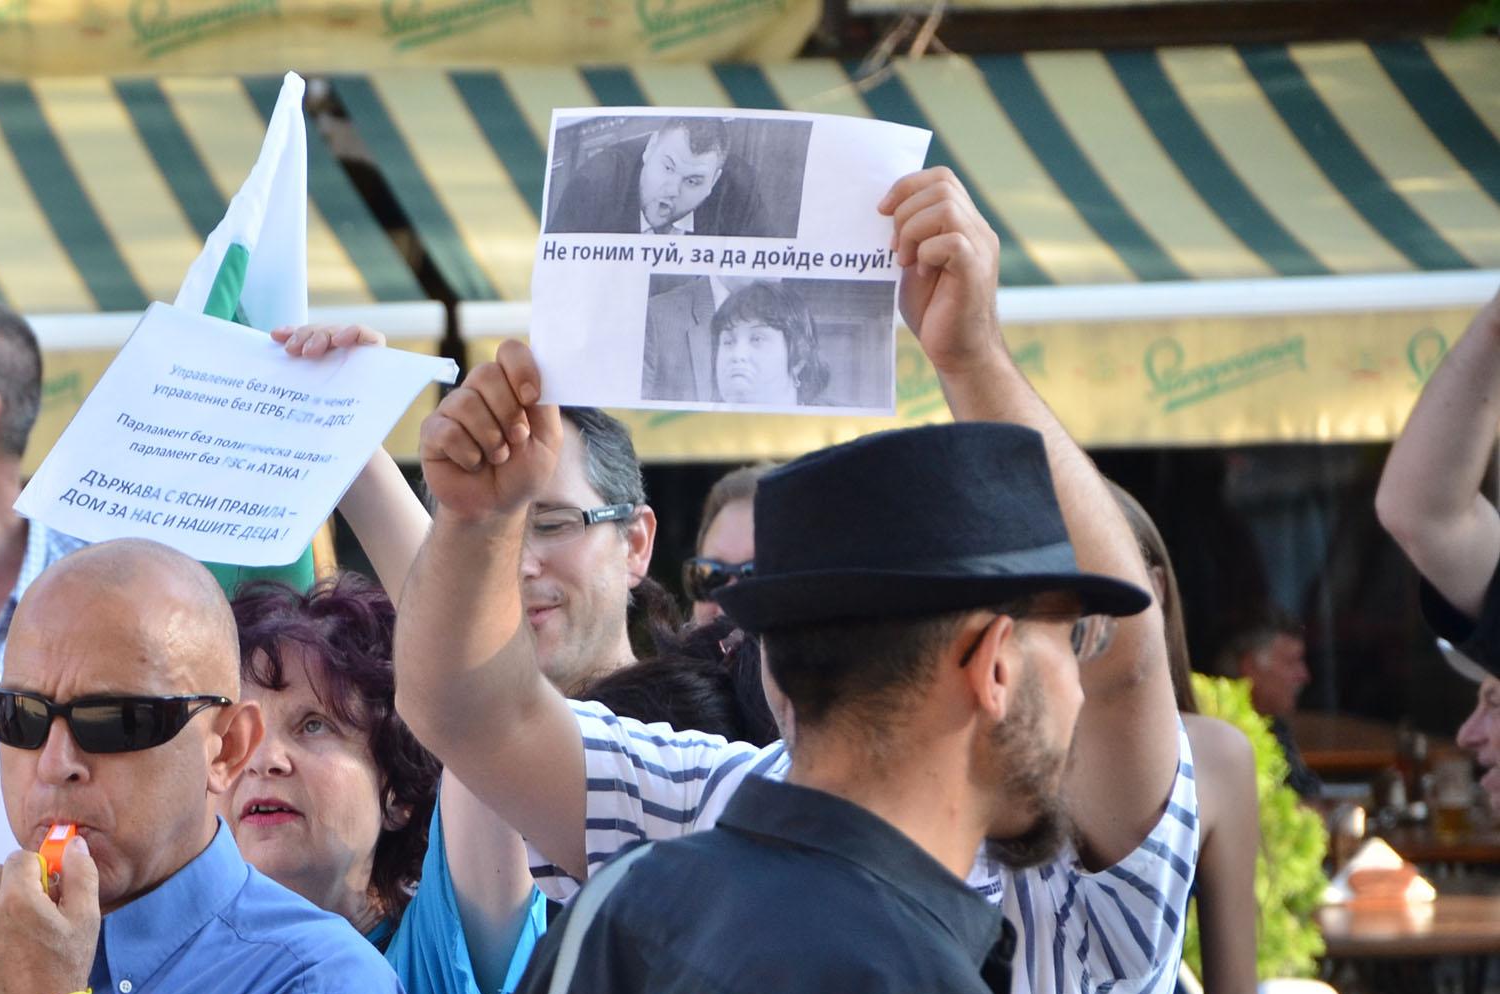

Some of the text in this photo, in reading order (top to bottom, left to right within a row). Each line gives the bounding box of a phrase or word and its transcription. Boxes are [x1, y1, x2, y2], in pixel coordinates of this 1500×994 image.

[542, 241, 893, 271] Не гоним туй, за да дойде онуй!
[152, 382, 229, 408] управление
[230, 397, 252, 412] без
[169, 363, 245, 389] Управление
[246, 378, 267, 394] без
[269, 384, 311, 403] мутра
[116, 412, 190, 440] Парламент
[190, 430, 212, 445] без
[213, 437, 292, 458] полическа
[129, 440, 196, 462] парламент
[198, 451, 220, 466] без
[256, 462, 300, 480] АТАКА
[79, 468, 163, 501] ДЪРЖАВА
[164, 489, 177, 502] С
[176, 490, 218, 511] ЯСНИ
[217, 498, 286, 519] ПРАВИЛА
[59, 487, 107, 514] ДОМ
[106, 502, 128, 519] ЗА
[130, 507, 162, 527] НАС
[162, 511, 177, 528] И
[176, 516, 243, 537] НАШИТЕ
[238, 525, 279, 542] ДЕЦА
